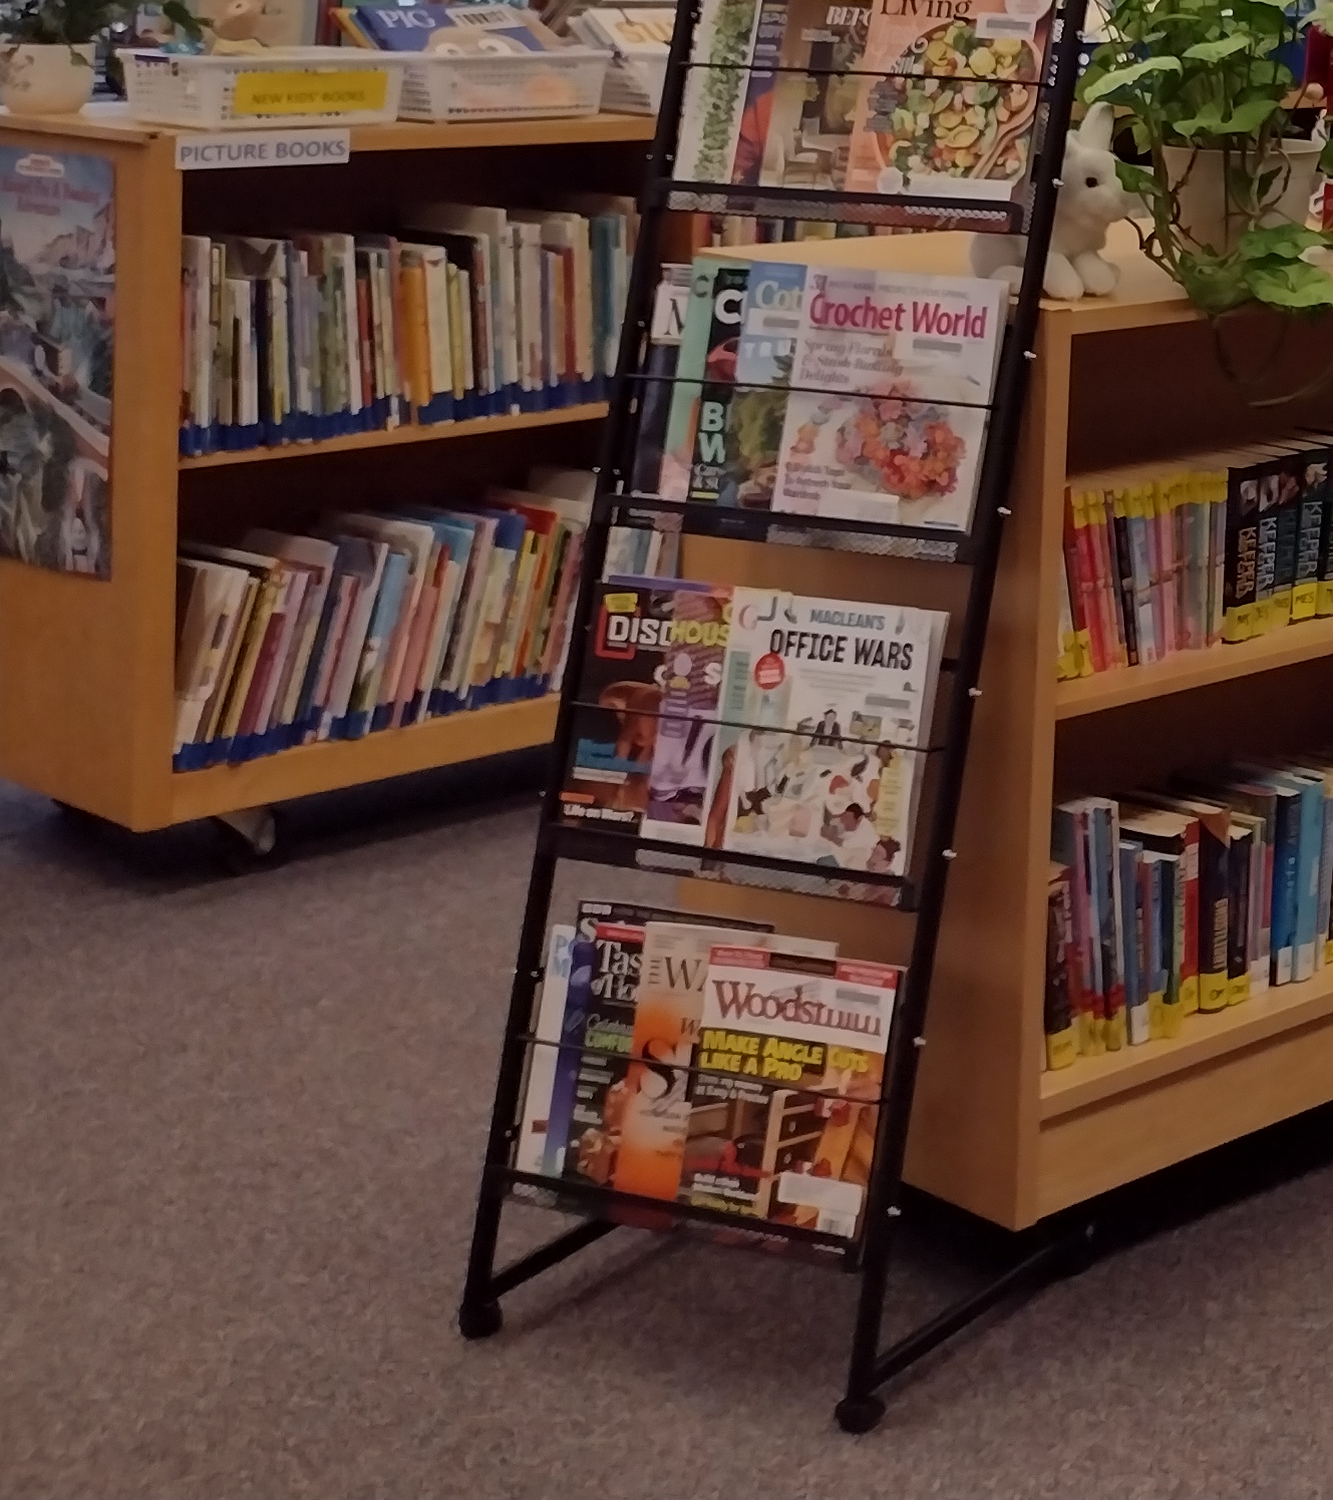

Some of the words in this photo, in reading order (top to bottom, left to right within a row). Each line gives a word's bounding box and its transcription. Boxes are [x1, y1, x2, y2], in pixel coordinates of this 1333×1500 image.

[180, 144, 268, 163] PICTURE
[275, 140, 346, 159] BOOKS
[810, 293, 906, 332] Crochet
[912, 301, 989, 339] World
[810, 608, 888, 630] MACLEAN'S
[770, 629, 846, 663] OFFICE
[854, 637, 914, 671] WARS
[700, 1050, 742, 1073] LIKE
[743, 1056, 758, 1076] A
[762, 1056, 804, 1082] PRO
[702, 1029, 760, 1056] MAKE
[763, 1037, 824, 1066] ANGLE
[828, 1046, 870, 1074] CUTS
